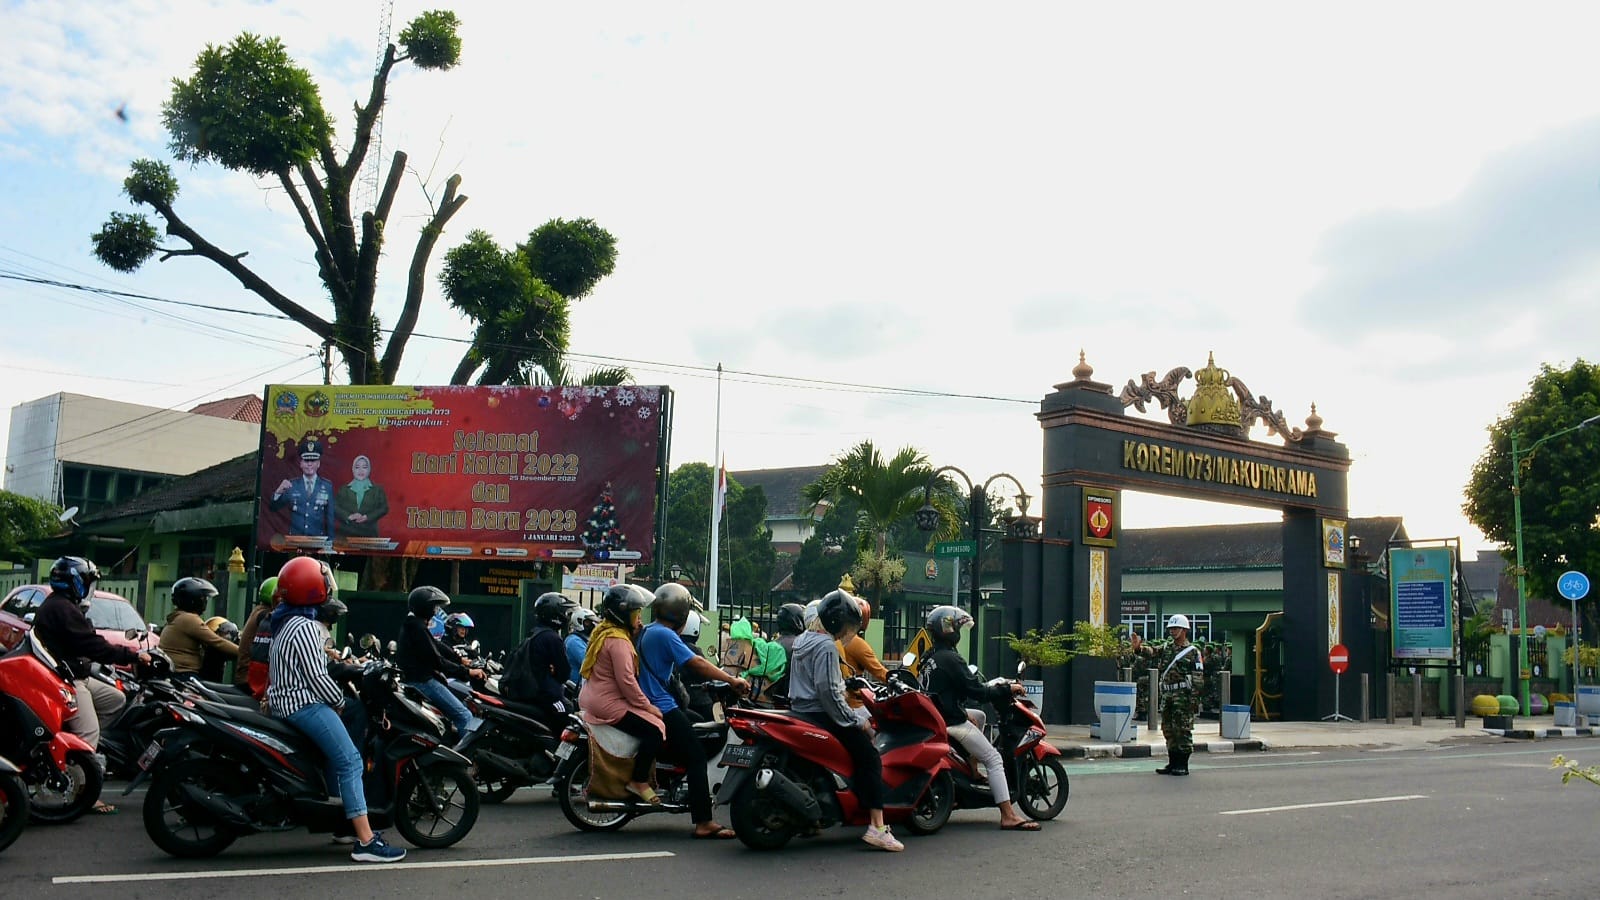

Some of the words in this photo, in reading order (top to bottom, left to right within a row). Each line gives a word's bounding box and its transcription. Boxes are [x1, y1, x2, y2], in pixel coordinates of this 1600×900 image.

[378, 416, 443, 428] Mengucapkan
[434, 408, 450, 416] 073
[453, 430, 539, 452] Selamat
[411, 451, 457, 474] Hari
[462, 452, 519, 475] Natal
[522, 453, 580, 476] 2022
[1123, 440, 1184, 477] KOREM
[472, 481, 510, 503] dan
[407, 506, 467, 530] Tahun
[470, 507, 521, 531] Baru
[524, 508, 578, 532] 2023
